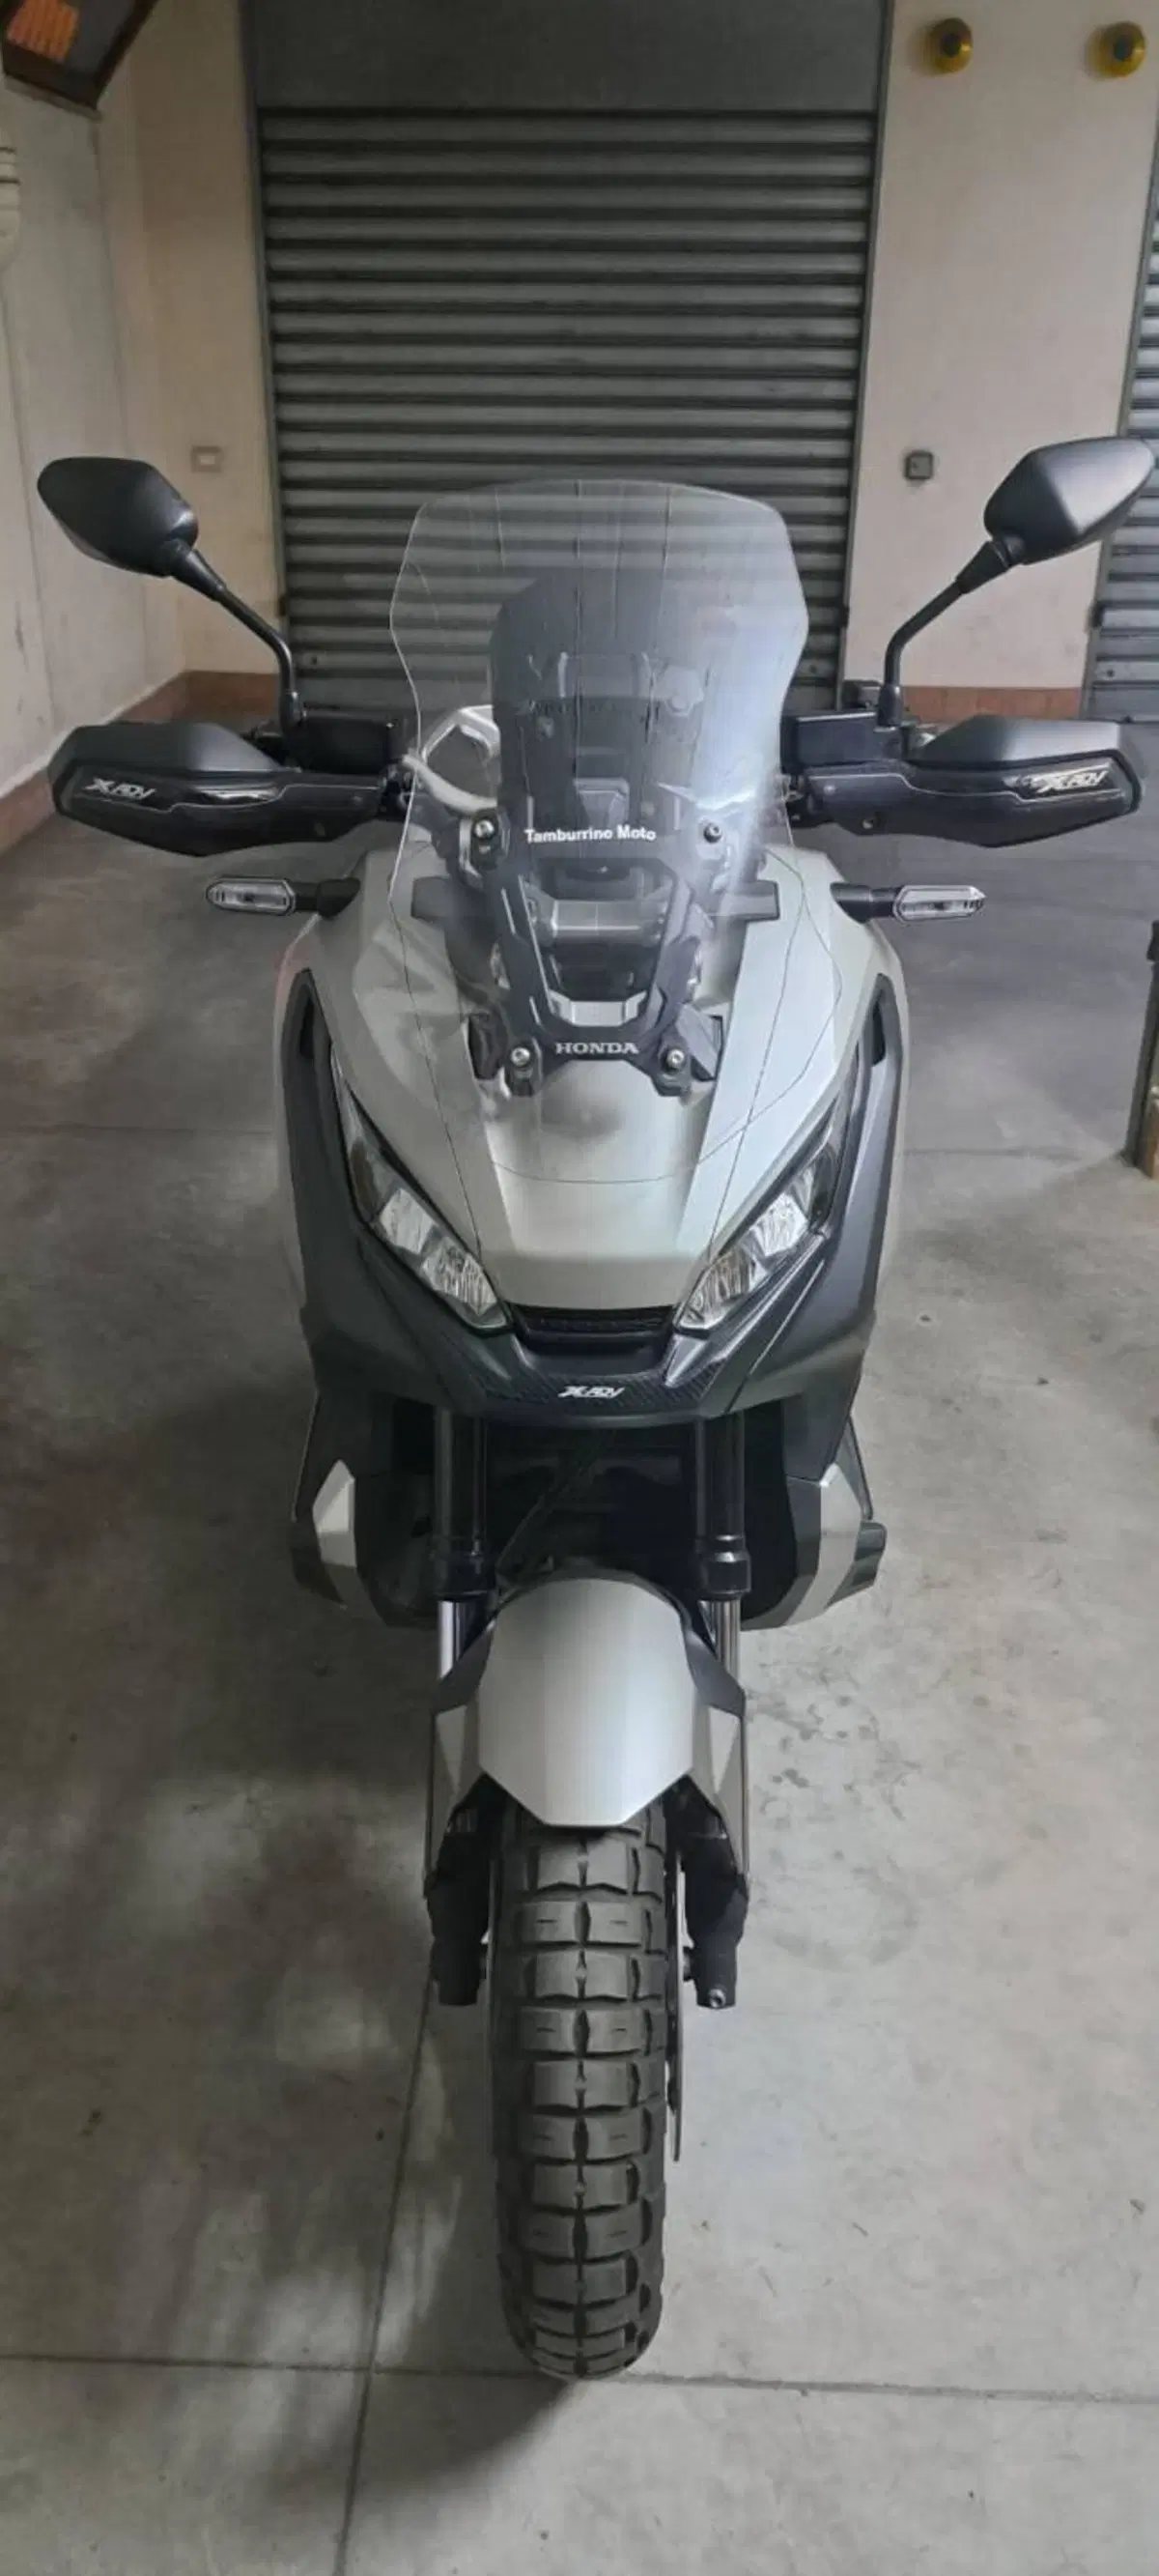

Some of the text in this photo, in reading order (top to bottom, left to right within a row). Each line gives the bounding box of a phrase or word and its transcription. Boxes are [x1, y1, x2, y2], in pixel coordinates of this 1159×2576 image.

[524, 824, 657, 844] Tamburrino Moto
[554, 1042, 638, 1055] HONDA
